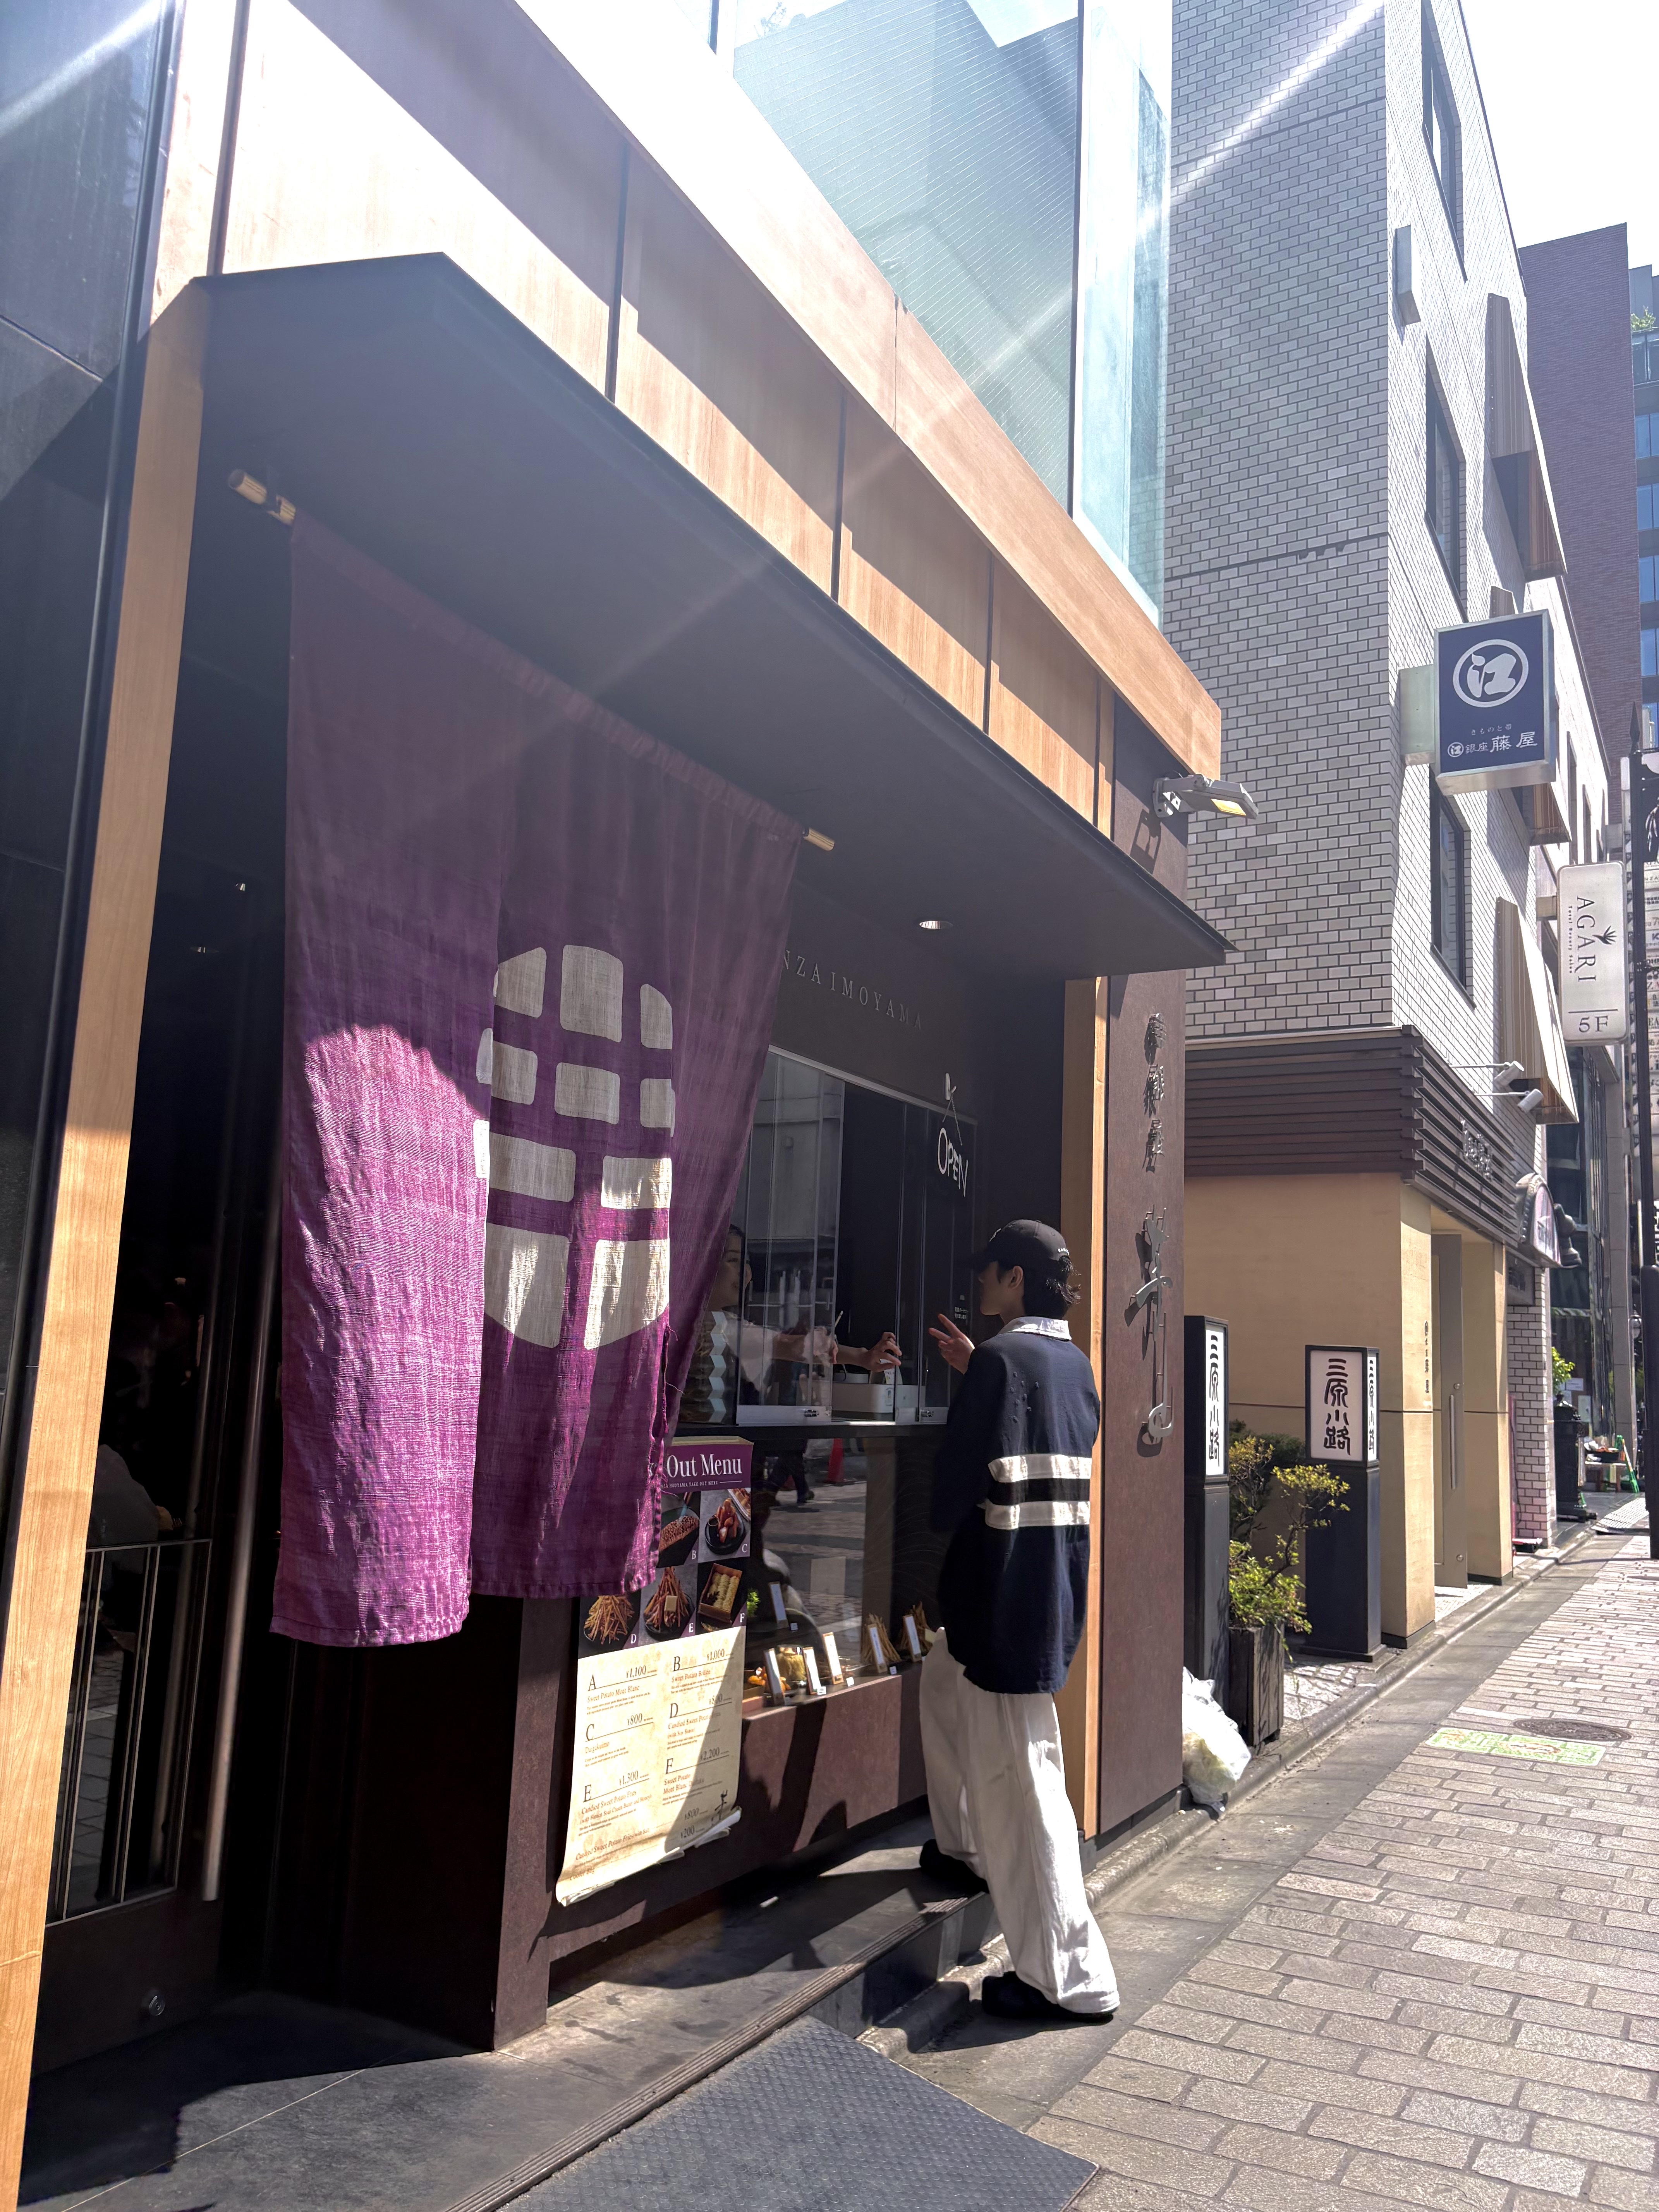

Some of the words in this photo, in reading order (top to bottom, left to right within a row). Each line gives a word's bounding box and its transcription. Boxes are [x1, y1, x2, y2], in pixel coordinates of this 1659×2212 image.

[1575, 896, 1596, 982] AGARI
[830, 971, 922, 1030] IMOYAMA
[1579, 1016, 1608, 1032] 5F
[1324, 1358, 1351, 1456] 三原小路
[667, 1455, 698, 1478] Out
[700, 1453, 742, 1476] Menu
[692, 1550, 696, 1559] B
[742, 1544, 747, 1553] C
[740, 1613, 744, 1623] F
[689, 1623, 694, 1633] E
[630, 1633, 636, 1644] D
[673, 1656, 680, 1672] B
[588, 1674, 597, 1691] A
[626, 1665, 646, 1678] ¥1,100
[669, 1703, 678, 1718] D
[586, 1724, 594, 1741] C
[627, 1713, 642, 1726] ¥800
[665, 1758, 673, 1774] F
[583, 1784, 591, 1802] E
[619, 1771, 639, 1786] ¥1,300
